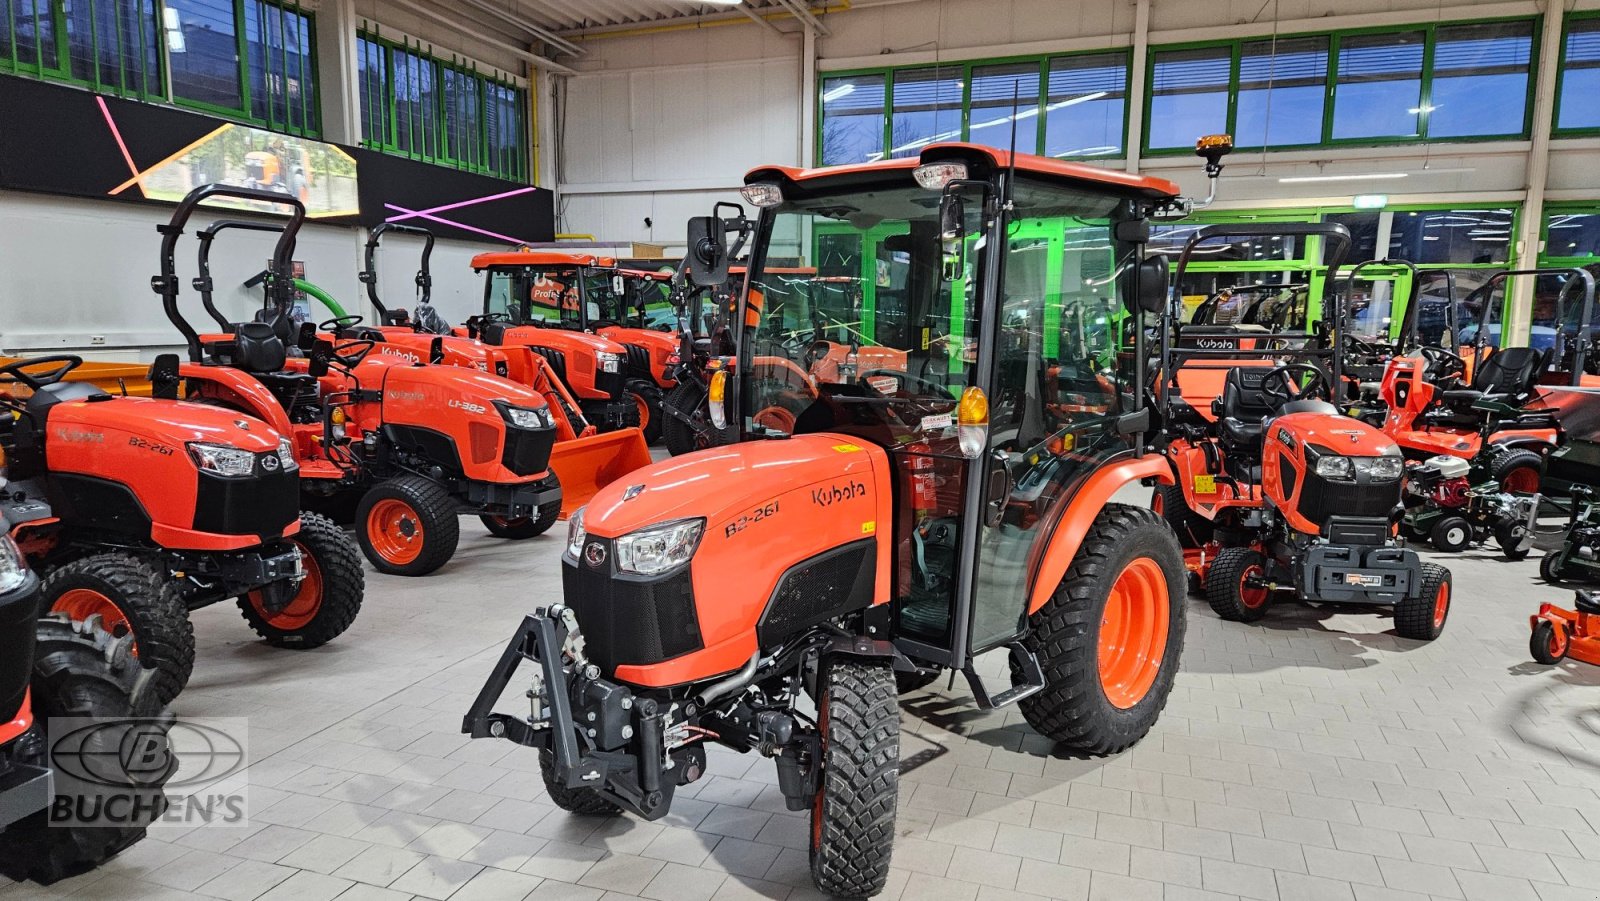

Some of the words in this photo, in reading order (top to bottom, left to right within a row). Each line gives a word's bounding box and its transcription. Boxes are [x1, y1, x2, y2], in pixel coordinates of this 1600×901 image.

[1196, 338, 1234, 349] Kubota
[381, 346, 420, 363] Kubota
[128, 436, 175, 456] B2-261
[812, 480, 866, 507] Kubota
[725, 501, 780, 539] B2-261
